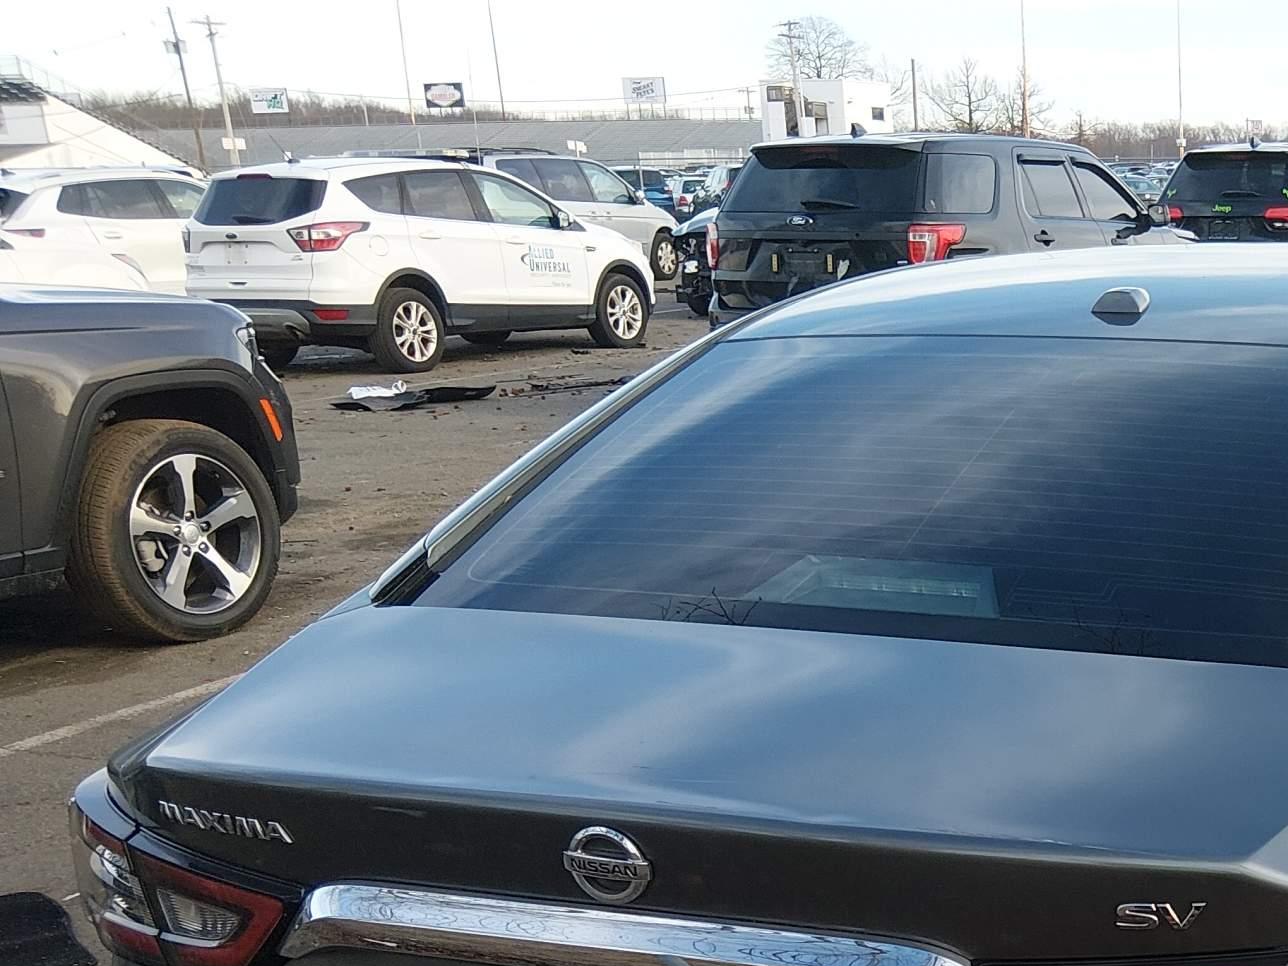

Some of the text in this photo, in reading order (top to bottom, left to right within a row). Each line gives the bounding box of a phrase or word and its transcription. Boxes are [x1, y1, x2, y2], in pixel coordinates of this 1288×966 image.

[1212, 204, 1232, 213] Jeep
[528, 243, 555, 260] ALLIED
[529, 258, 571, 273] UNIVERSAL
[158, 800, 294, 844] MAXIMA
[570, 858, 638, 878] NISSAN
[1115, 902, 1208, 930] SV
